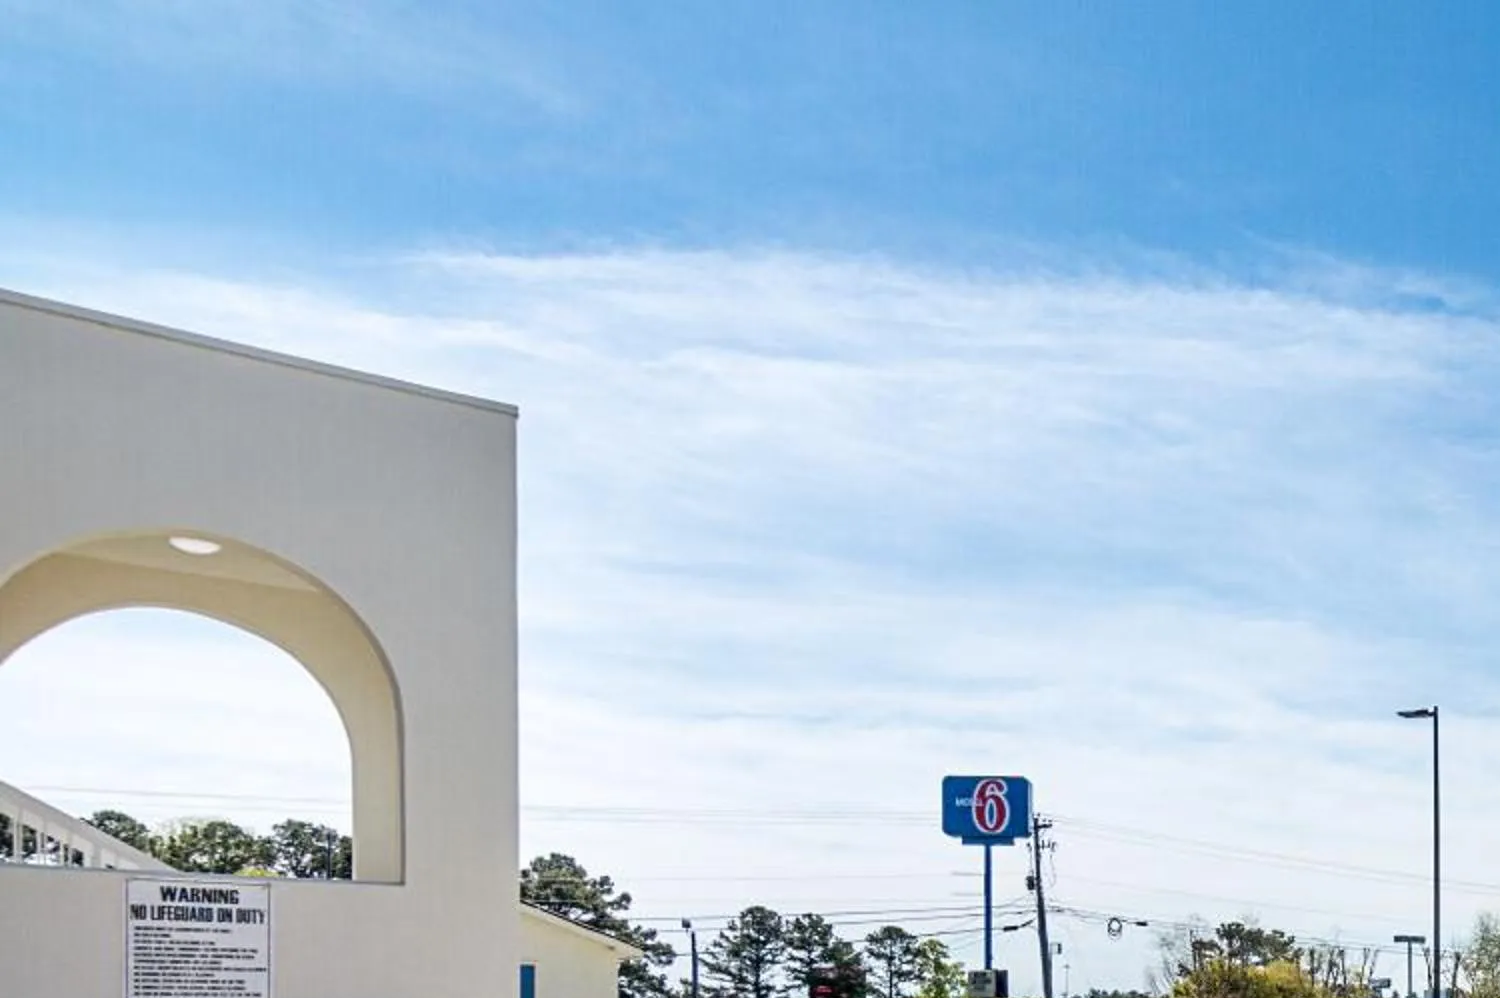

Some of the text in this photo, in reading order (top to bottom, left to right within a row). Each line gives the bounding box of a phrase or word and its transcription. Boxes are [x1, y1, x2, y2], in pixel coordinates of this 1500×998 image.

[972, 778, 1010, 833] 6
[160, 885, 239, 904] WARNING
[130, 904, 265, 924] NO LIFEGUARD ON DUTY
